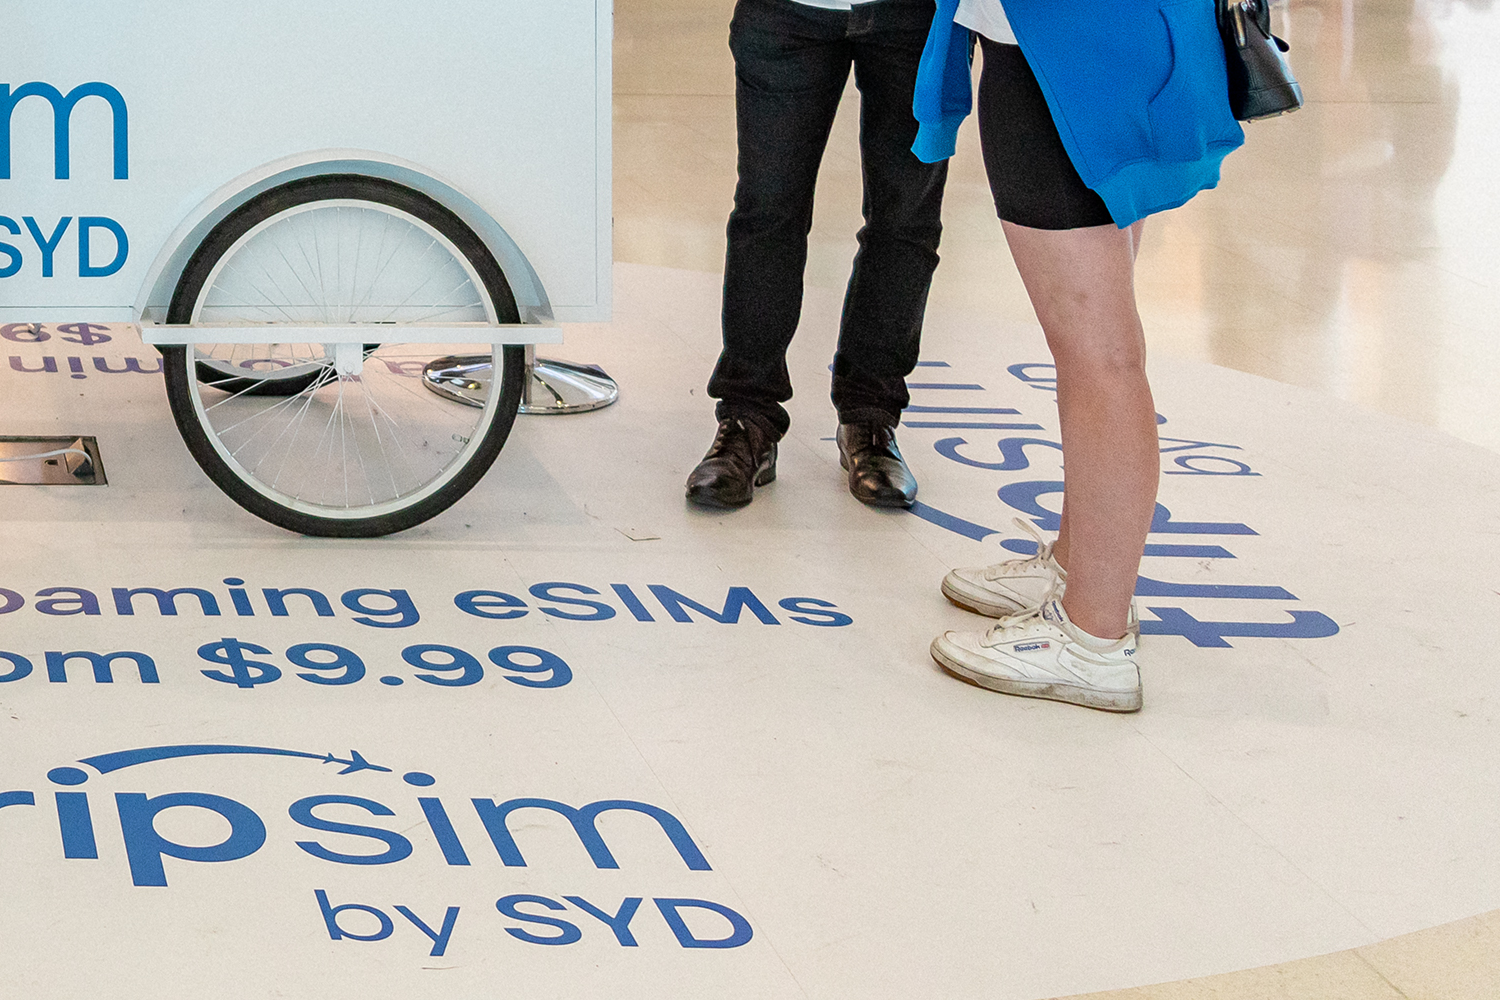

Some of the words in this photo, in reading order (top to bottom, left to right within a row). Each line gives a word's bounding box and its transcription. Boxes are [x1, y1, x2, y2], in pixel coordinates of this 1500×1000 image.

[453, 582, 853, 627] eSIMs
[197, 637, 573, 689] $9.99
[1014, 644, 1040, 652] Reebok
[314, 889, 460, 956] by
[495, 894, 754, 949] SYD
